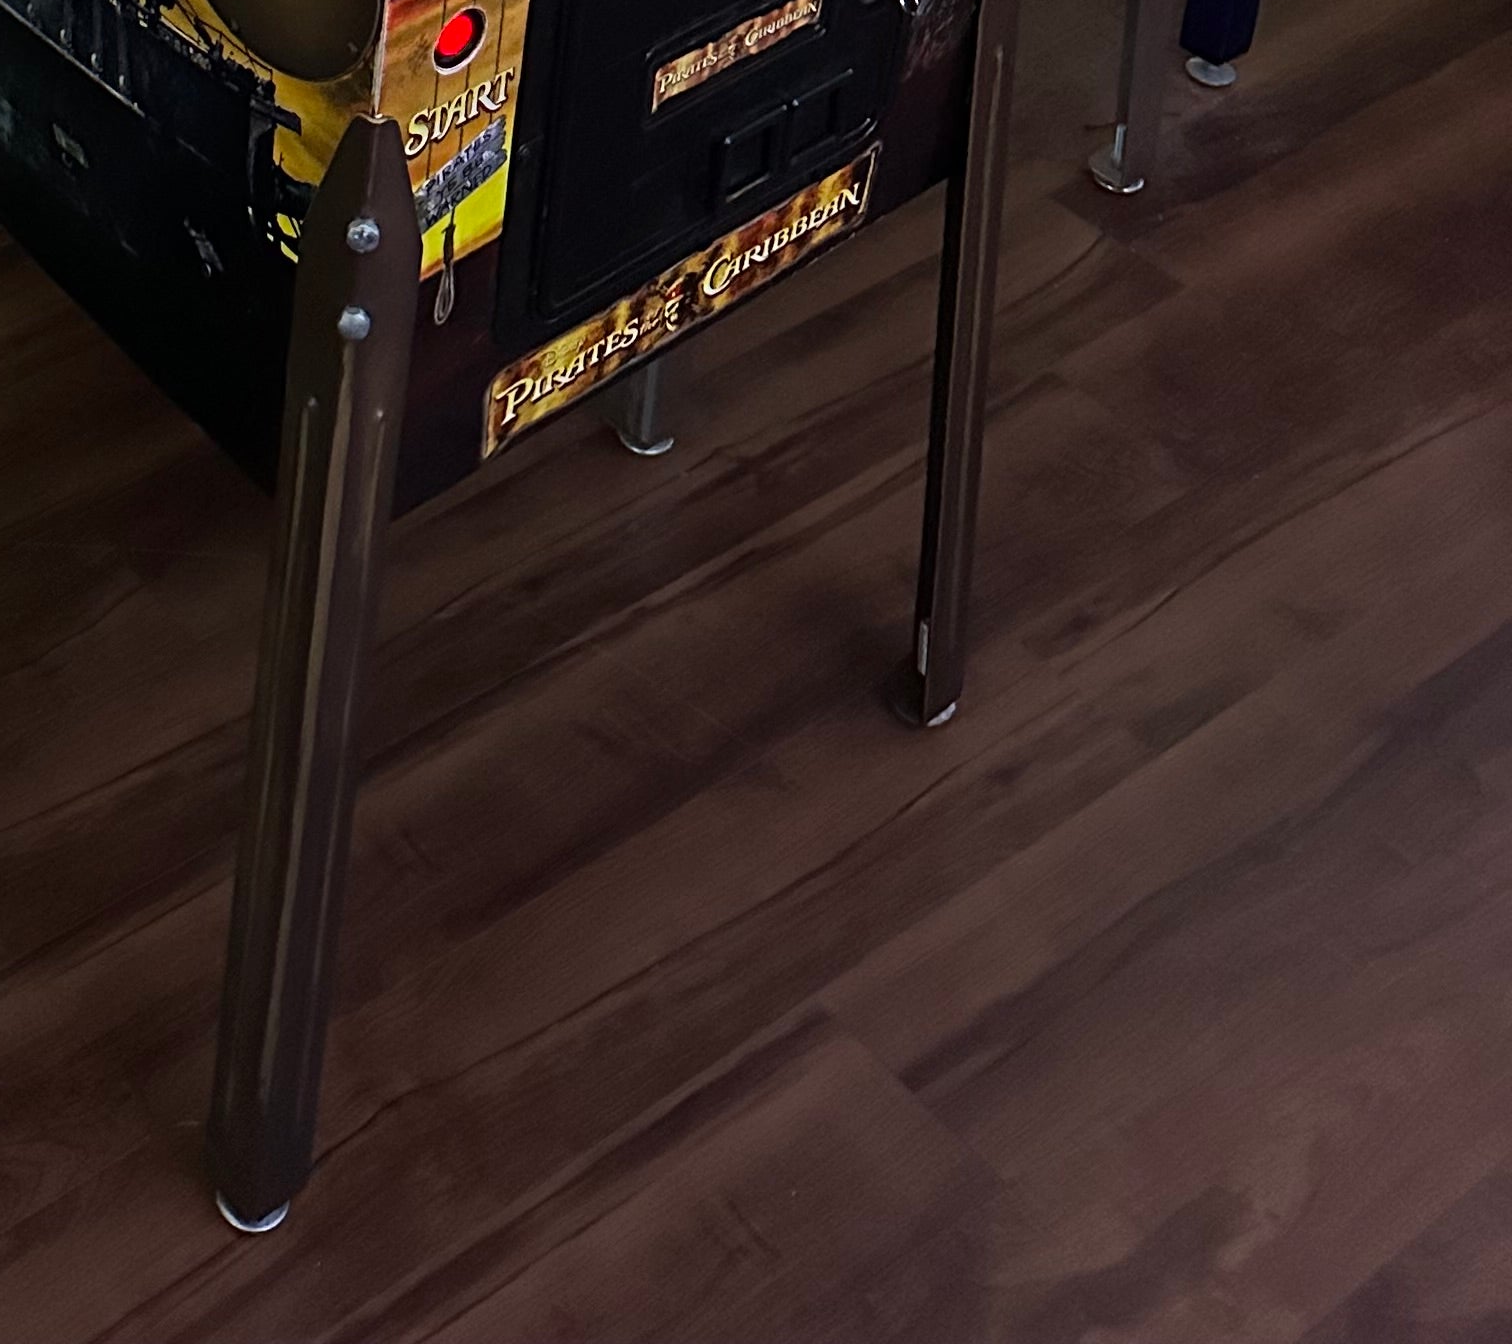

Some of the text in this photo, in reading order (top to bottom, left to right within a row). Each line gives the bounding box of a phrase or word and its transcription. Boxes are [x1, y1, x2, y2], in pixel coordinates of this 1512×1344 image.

[404, 67, 515, 156] START
[495, 182, 860, 426] PIRATES CARIBBEAN
